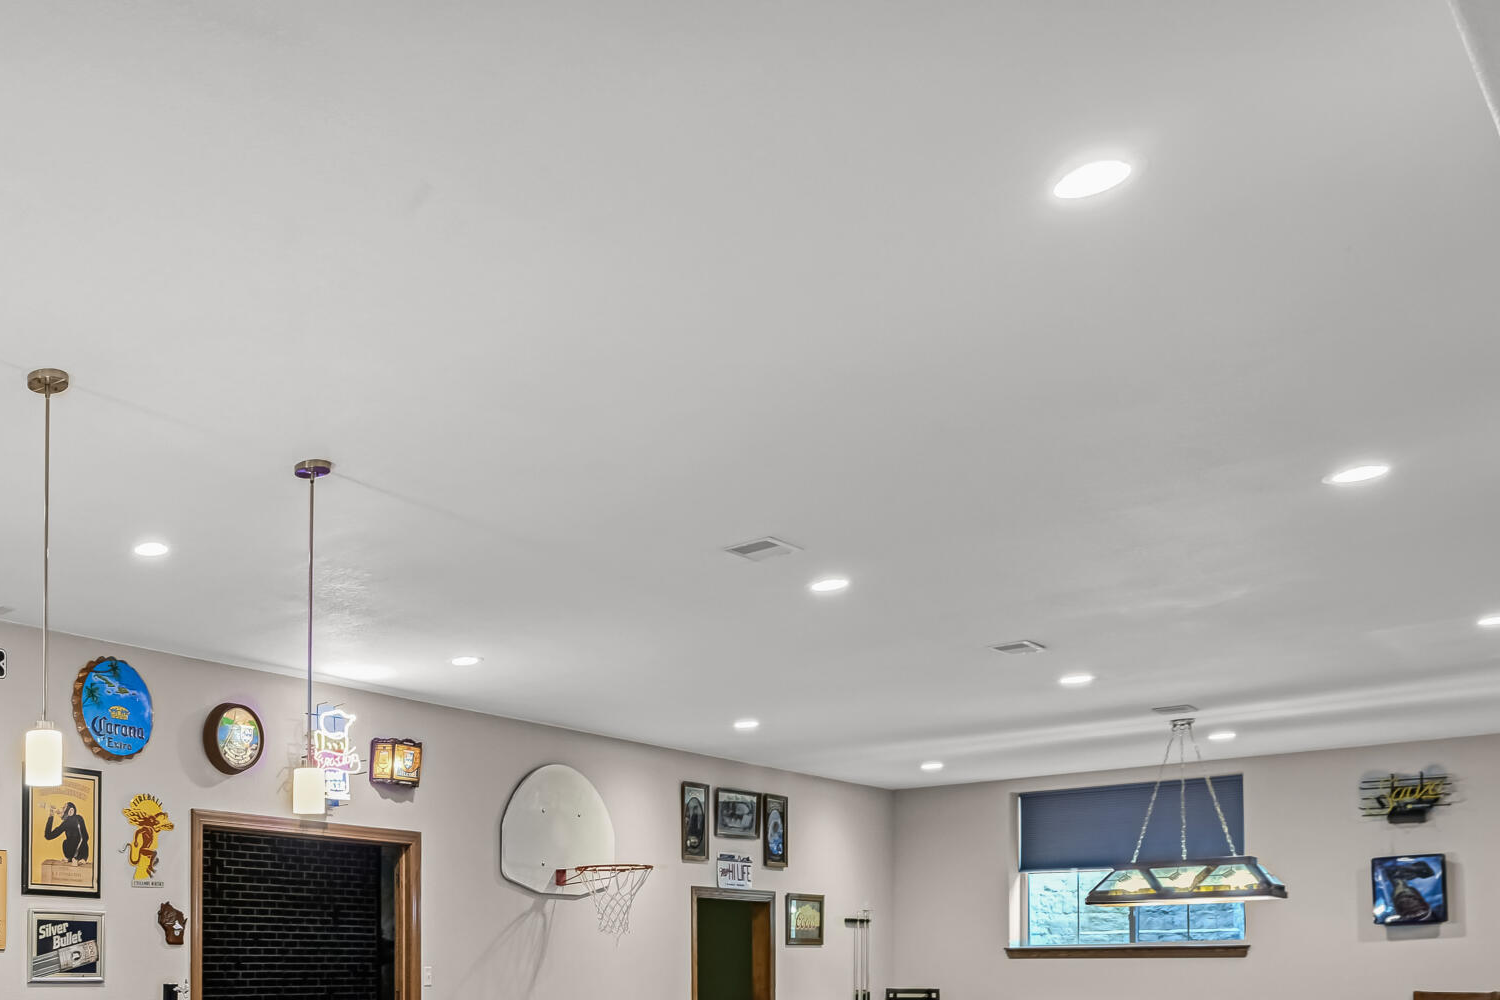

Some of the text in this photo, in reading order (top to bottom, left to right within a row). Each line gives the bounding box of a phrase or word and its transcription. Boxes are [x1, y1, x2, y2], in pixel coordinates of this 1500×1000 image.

[91, 716, 145, 740] Corona
[107, 737, 132, 751] Extra
[38, 922, 69, 940] Silver
[52, 930, 82, 950] Bullet
